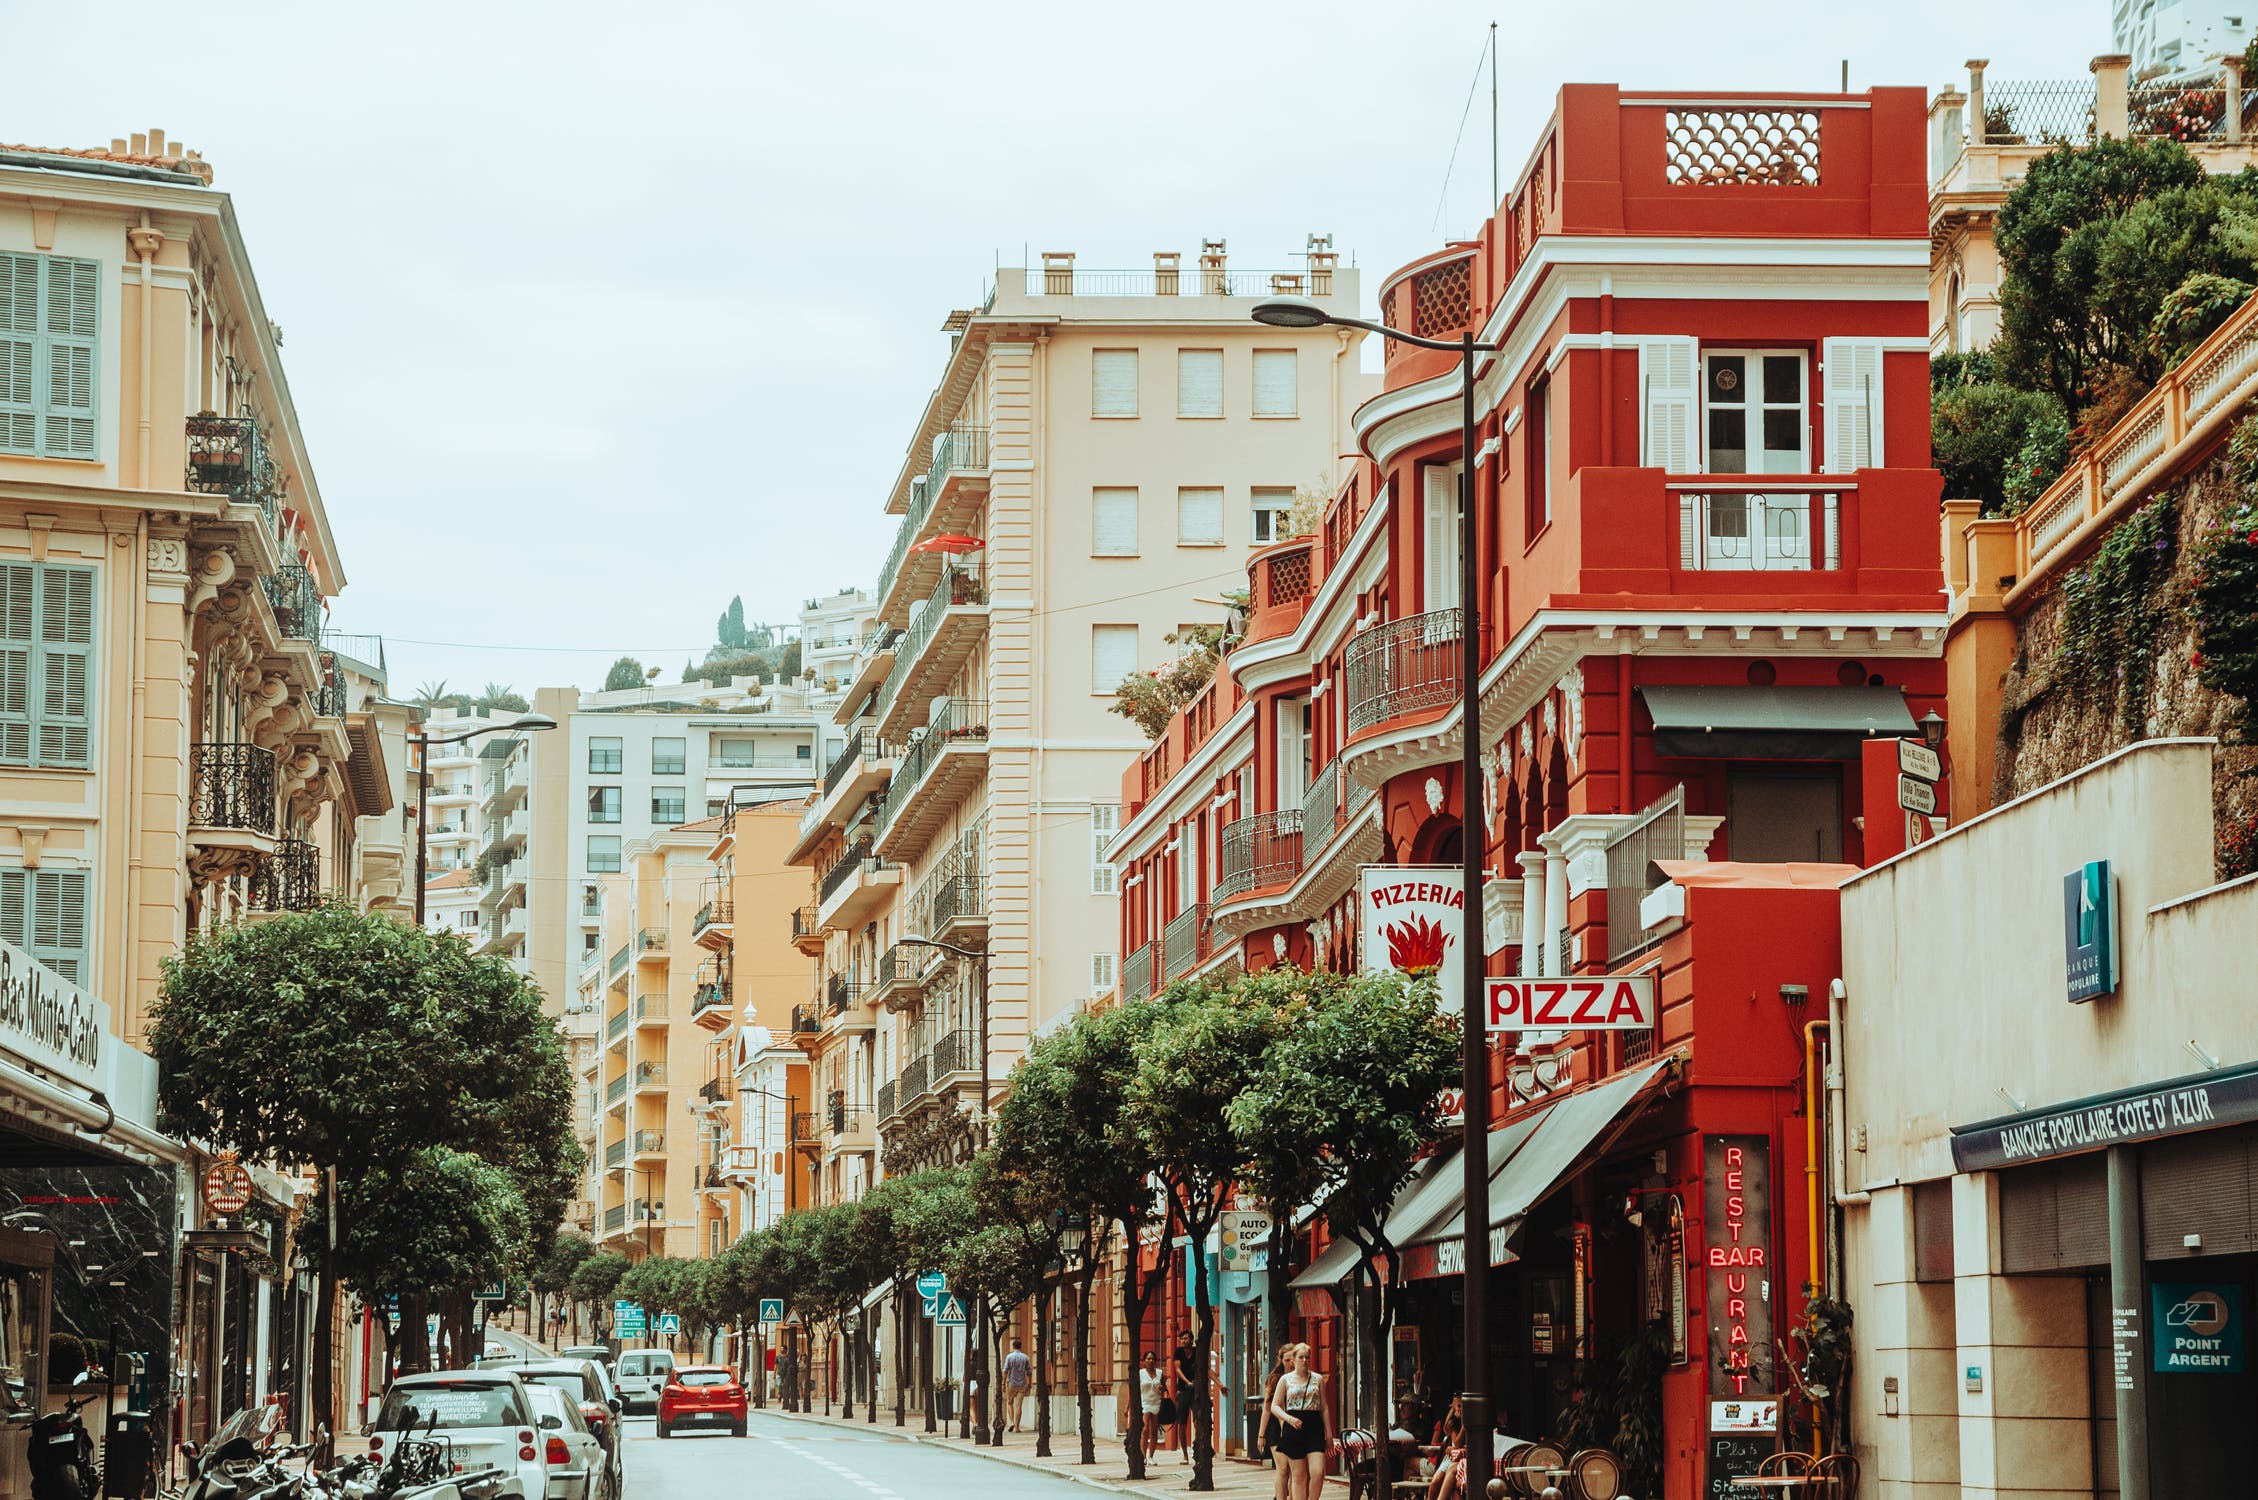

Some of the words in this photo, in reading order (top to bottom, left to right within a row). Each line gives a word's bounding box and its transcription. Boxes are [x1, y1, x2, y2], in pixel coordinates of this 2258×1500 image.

[1370, 882, 1465, 910] PIZZERIA
[2067, 955, 2099, 976] BANQUE
[2068, 972, 2099, 993] POPULAIRE
[1490, 982, 1645, 1025] PIZZA
[27, 966, 99, 1069] Monte-Carlo
[2001, 1121, 2051, 1159] BANQUE
[2048, 1107, 2118, 1149] POPULAIRE
[2115, 1099, 2155, 1136] COTE
[2170, 1088, 2215, 1127] AZUR
[1240, 1220, 1267, 1229] AUTO
[1240, 1231, 1262, 1240] ECO
[1438, 1237, 1466, 1274] SERVIC
[1709, 1248, 1764, 1267] BAR
[1726, 1147, 1748, 1394] RESTAURANT
[2175, 1337, 2222, 1350] POINT
[2168, 1353, 2231, 1366] ARGENT
